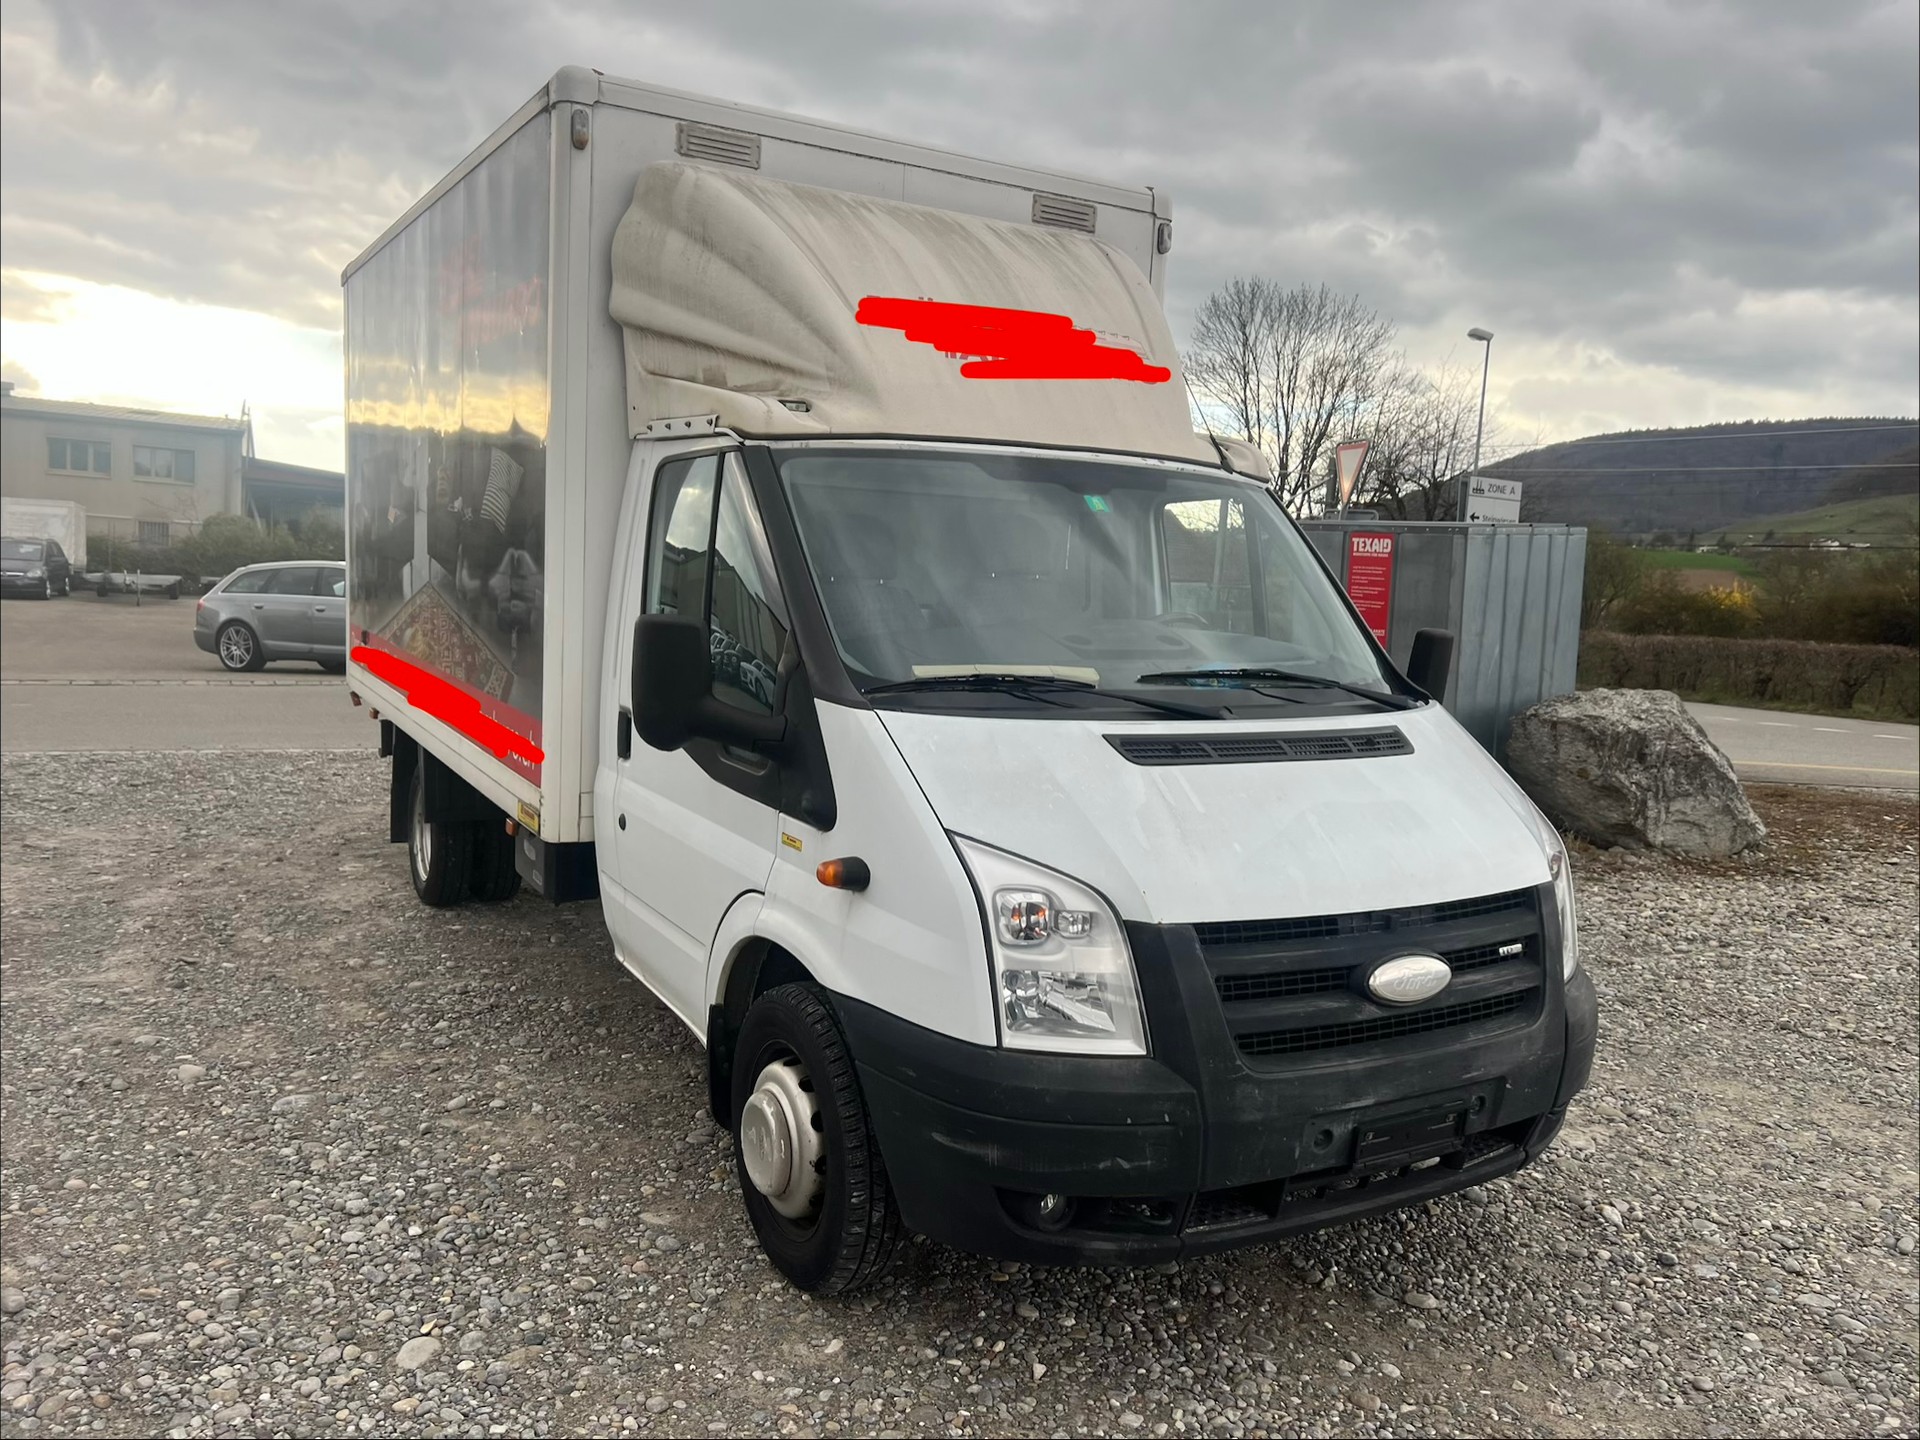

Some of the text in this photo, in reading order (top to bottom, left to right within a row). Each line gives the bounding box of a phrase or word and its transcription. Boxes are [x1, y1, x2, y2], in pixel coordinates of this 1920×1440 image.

[1487, 483, 1516, 496] ZONE A
[1352, 537, 1392, 553] TEXAID
